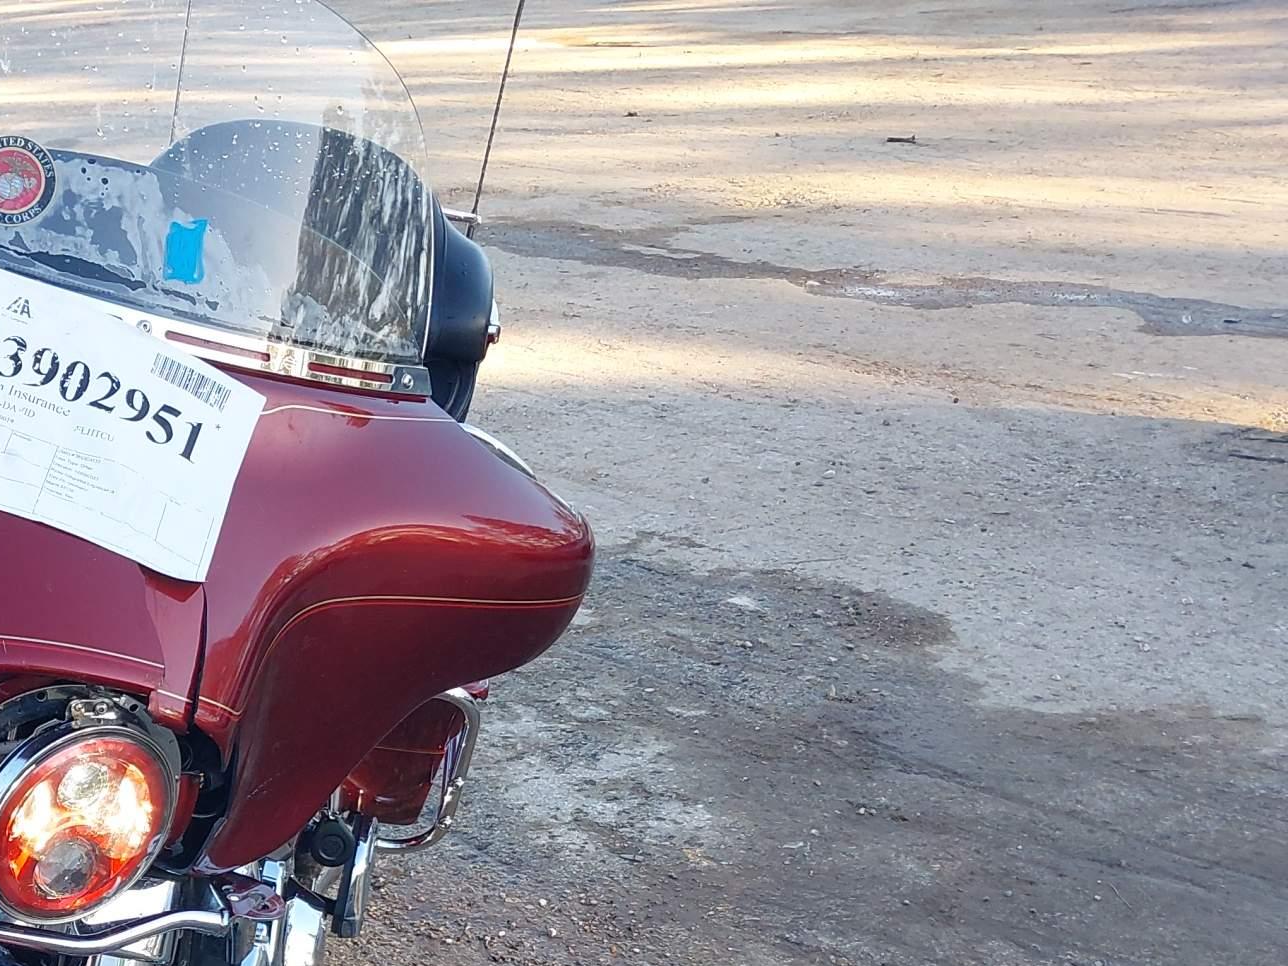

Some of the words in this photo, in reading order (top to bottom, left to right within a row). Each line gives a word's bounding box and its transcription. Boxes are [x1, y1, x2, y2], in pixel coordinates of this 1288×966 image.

[25, 142, 54, 178] STATES
[4, 205, 42, 224] CORPS
[8, 385, 71, 416] Insurance
